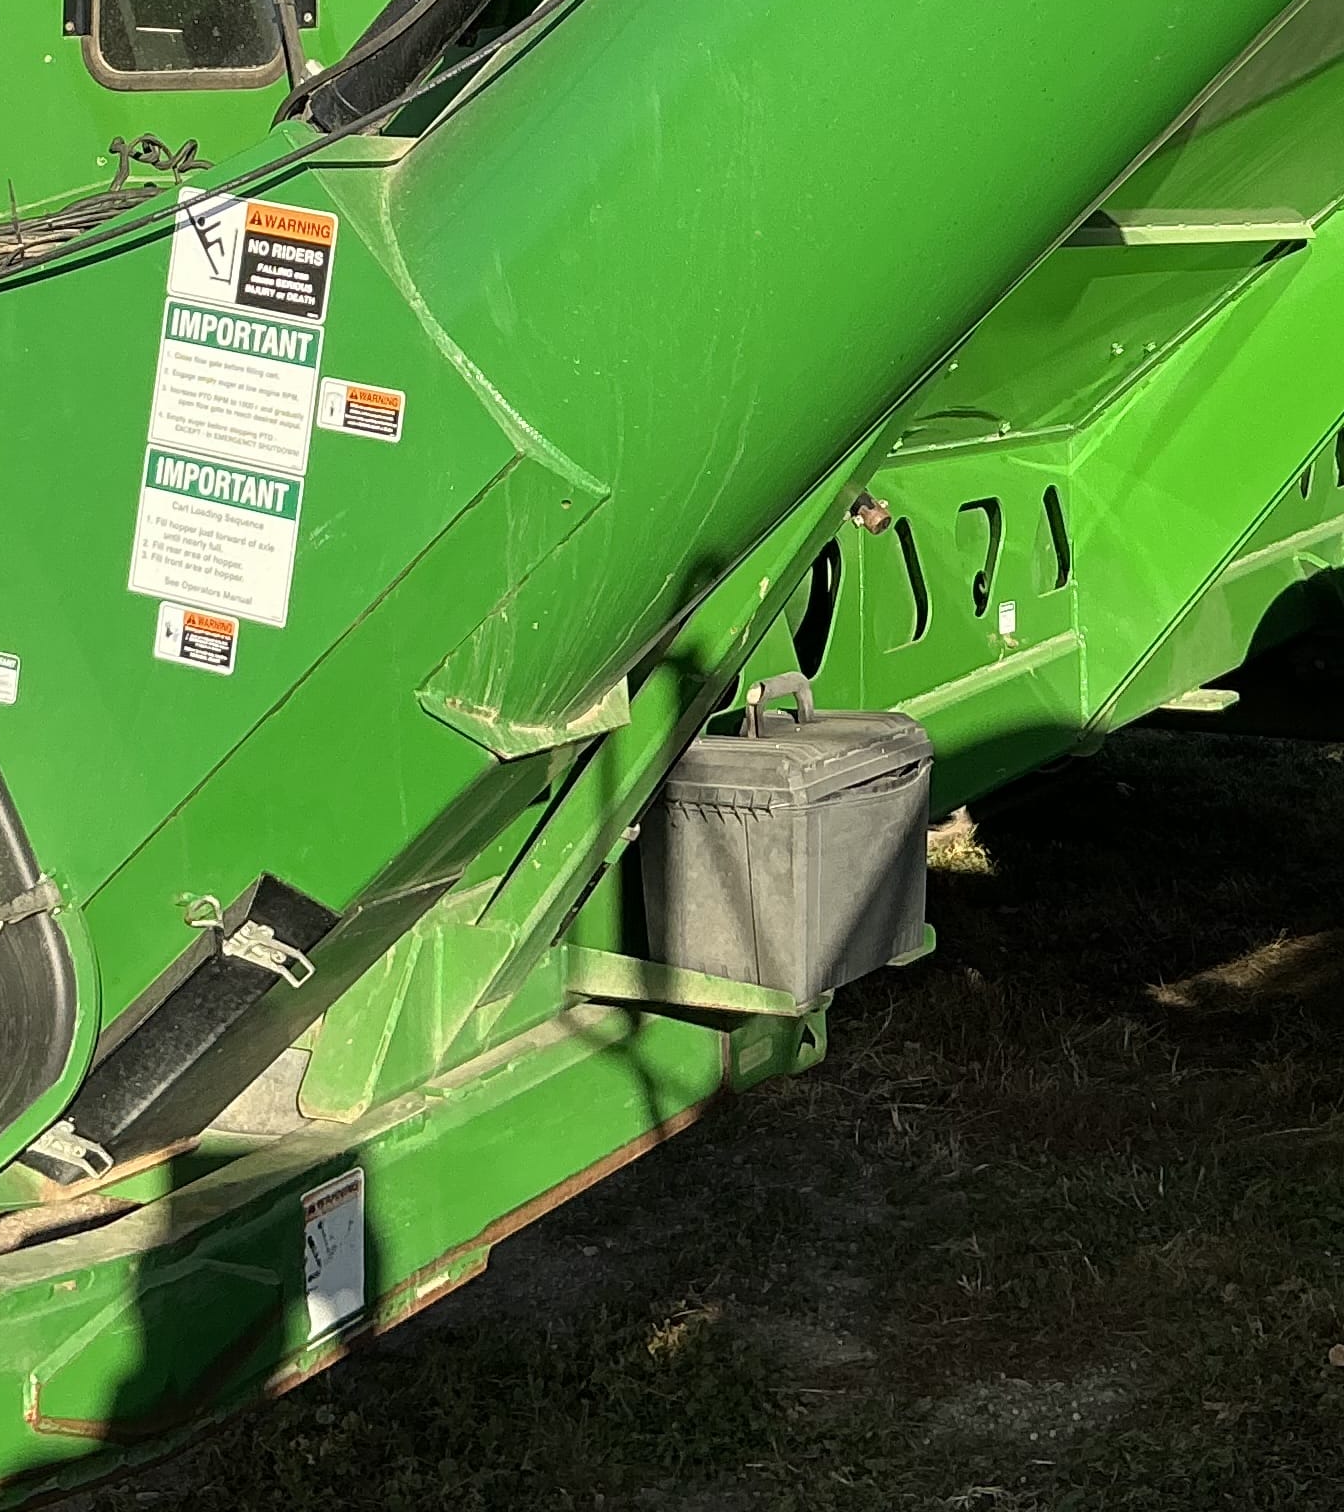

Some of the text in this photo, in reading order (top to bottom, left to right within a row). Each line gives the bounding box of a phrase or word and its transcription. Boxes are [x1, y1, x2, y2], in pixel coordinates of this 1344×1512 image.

[265, 214, 331, 238] WARNING
[248, 238, 324, 267] NO RIDERS
[257, 263, 293, 278] FALLING
[244, 284, 276, 298] INJURY
[286, 291, 316, 305] DEATH
[276, 278, 313, 294] SERIOUS
[170, 308, 314, 362] IMPORTANT
[198, 391, 213, 401] PTO
[274, 408, 304, 422] gradually
[359, 391, 398, 407] WARNING
[166, 412, 186, 424] Empty
[259, 432, 274, 441] PTO
[214, 433, 257, 448] EMERGENCY
[155, 456, 290, 512] IMPORTANT
[172, 501, 264, 530] Cart Loading Sequence
[156, 516, 167, 526] Fill
[169, 520, 197, 533] hopper
[198, 527, 214, 538] just
[216, 531, 247, 545] forward
[248, 539, 257, 548] of
[258, 542, 275, 552] axle
[182, 537, 206, 551] nearly
[151, 552, 163, 563] Fill
[165, 555, 183, 568] front
[185, 563, 202, 573] area
[204, 566, 213, 575] of
[214, 568, 244, 583] hopper.
[152, 540, 164, 551] Fill
[166, 546, 182, 554] rear
[184, 550, 201, 560] area
[203, 554, 211, 562] of
[213, 555, 243, 569] hopper.
[165, 576, 180, 587] See
[223, 591, 253, 605] Manual
